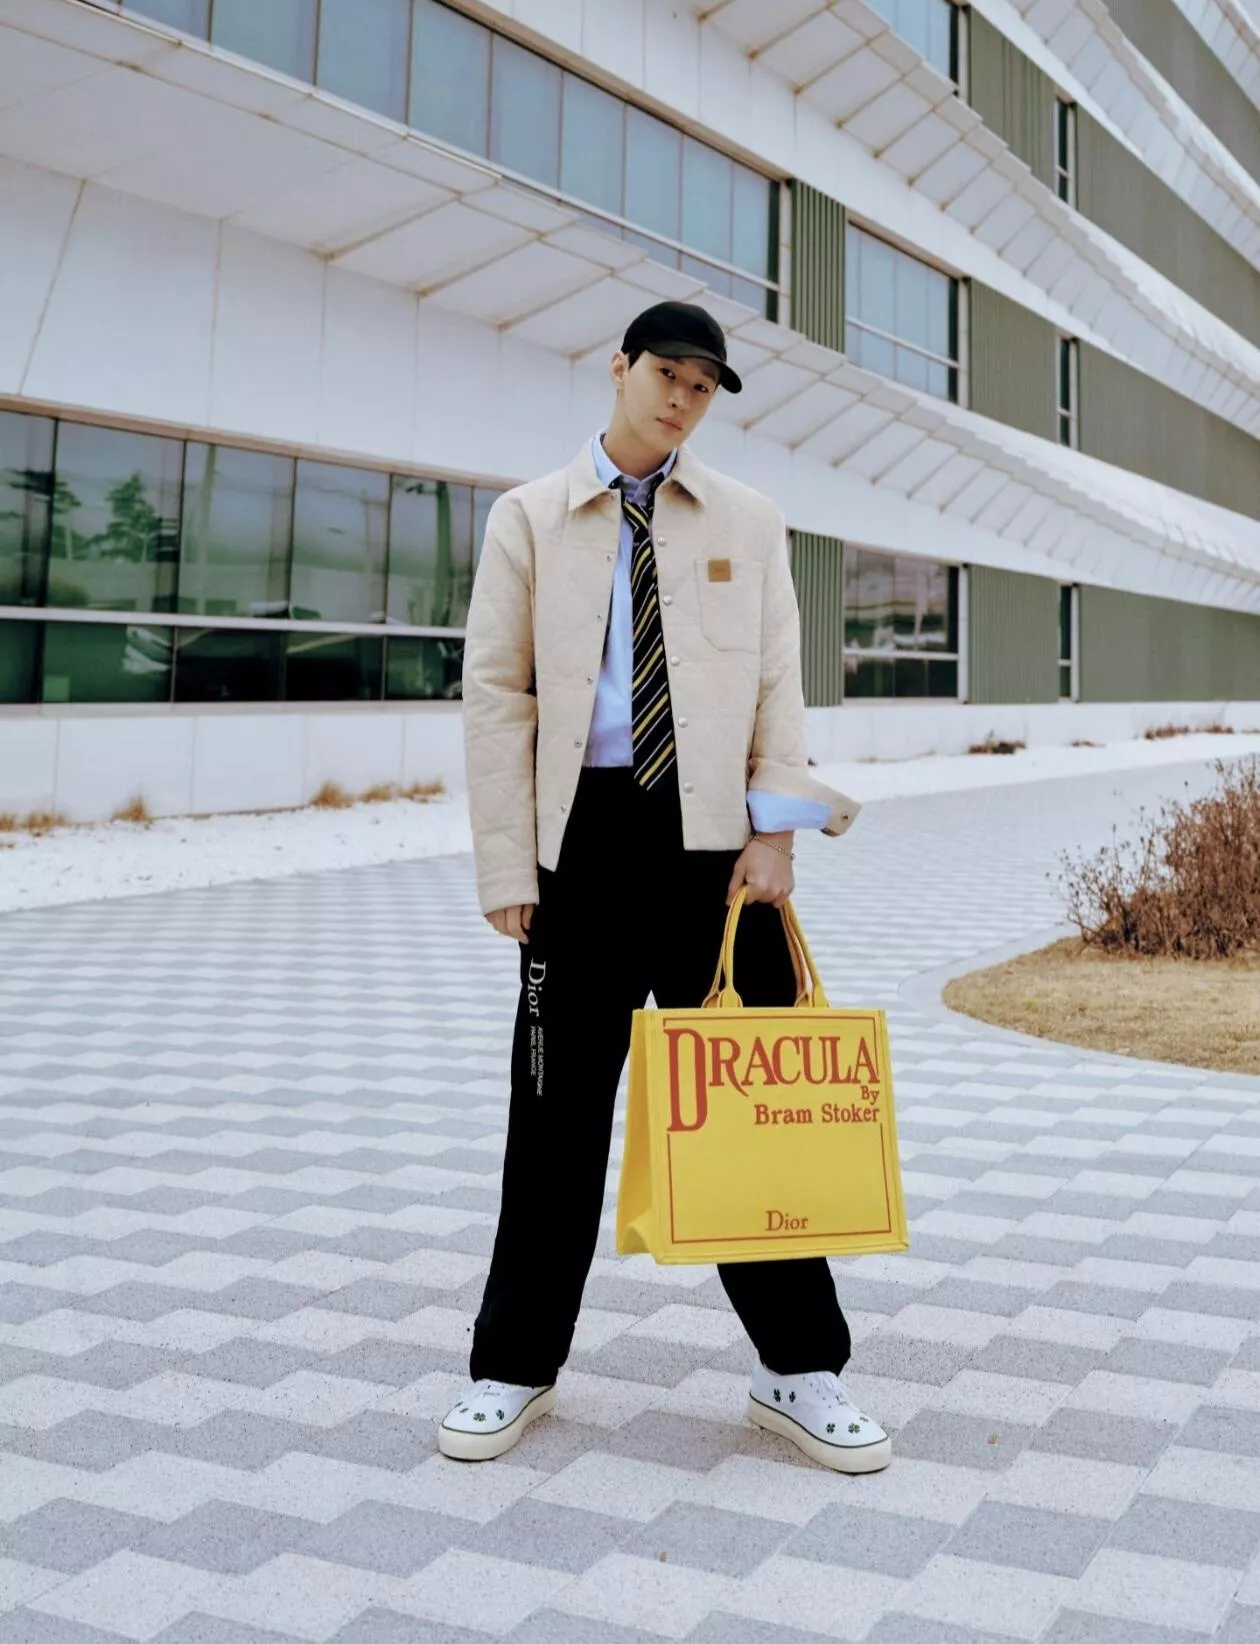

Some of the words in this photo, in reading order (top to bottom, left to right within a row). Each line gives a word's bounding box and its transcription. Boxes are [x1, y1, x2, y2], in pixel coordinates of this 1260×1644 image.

[528, 957, 546, 1017] Dior
[663, 1028, 880, 1132] DRACULA
[860, 1085, 880, 1104] By
[754, 1104, 813, 1125] Bram
[821, 1103, 880, 1123] Stoker
[765, 1210, 808, 1231] Dior
